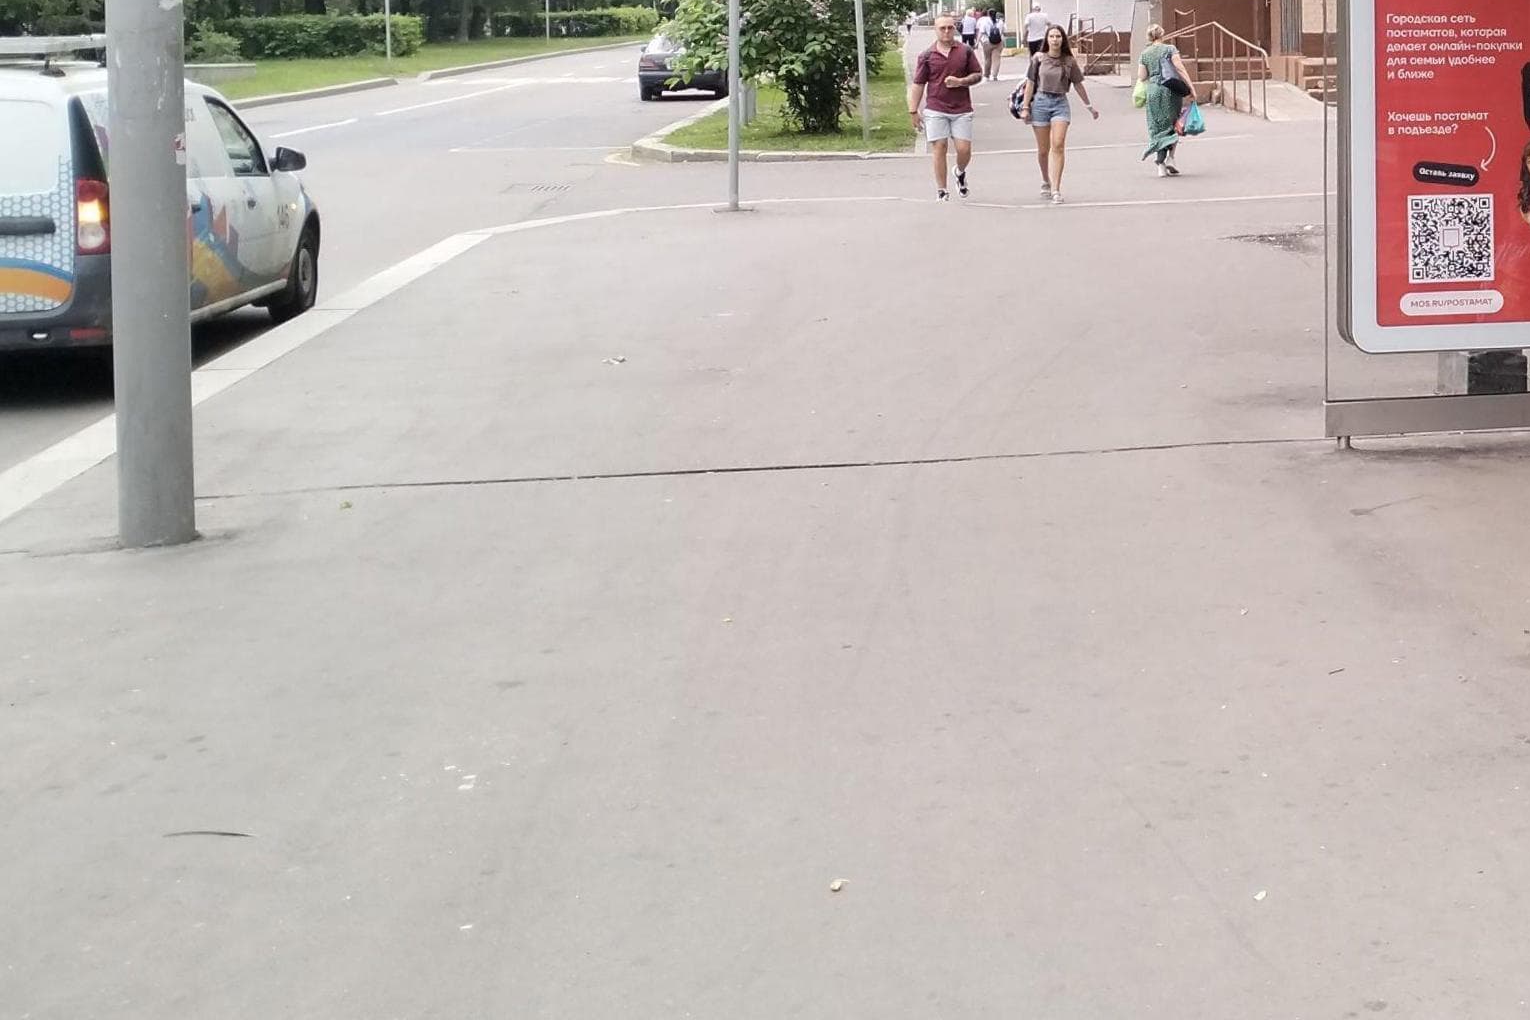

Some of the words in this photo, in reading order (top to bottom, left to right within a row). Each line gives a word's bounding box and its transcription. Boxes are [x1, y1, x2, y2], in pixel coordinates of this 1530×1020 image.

[1386, 13, 1447, 25] Городская
[1450, 15, 1476, 23] сеть
[1386, 29, 1458, 38] постаматов,
[1460, 28, 1507, 38] которая
[1386, 42, 1427, 52] делает
[1429, 40, 1523, 52] онлайн-покупки
[1386, 56, 1407, 66] для
[1409, 55, 1446, 65] семьи
[1448, 54, 1496, 66] удобнее
[1387, 71, 1395, 80] и
[1397, 68, 1434, 79] ближе
[1387, 111, 1432, 122] Хочешь
[1434, 112, 1489, 121] постамат
[1387, 127, 1395, 135] в
[1398, 123, 1459, 135] подъезде?
[1418, 167, 1447, 177] Оставь
[1448, 171, 1475, 181] заявку
[1410, 298, 1493, 308] MOS.RU/POSTAMAT
